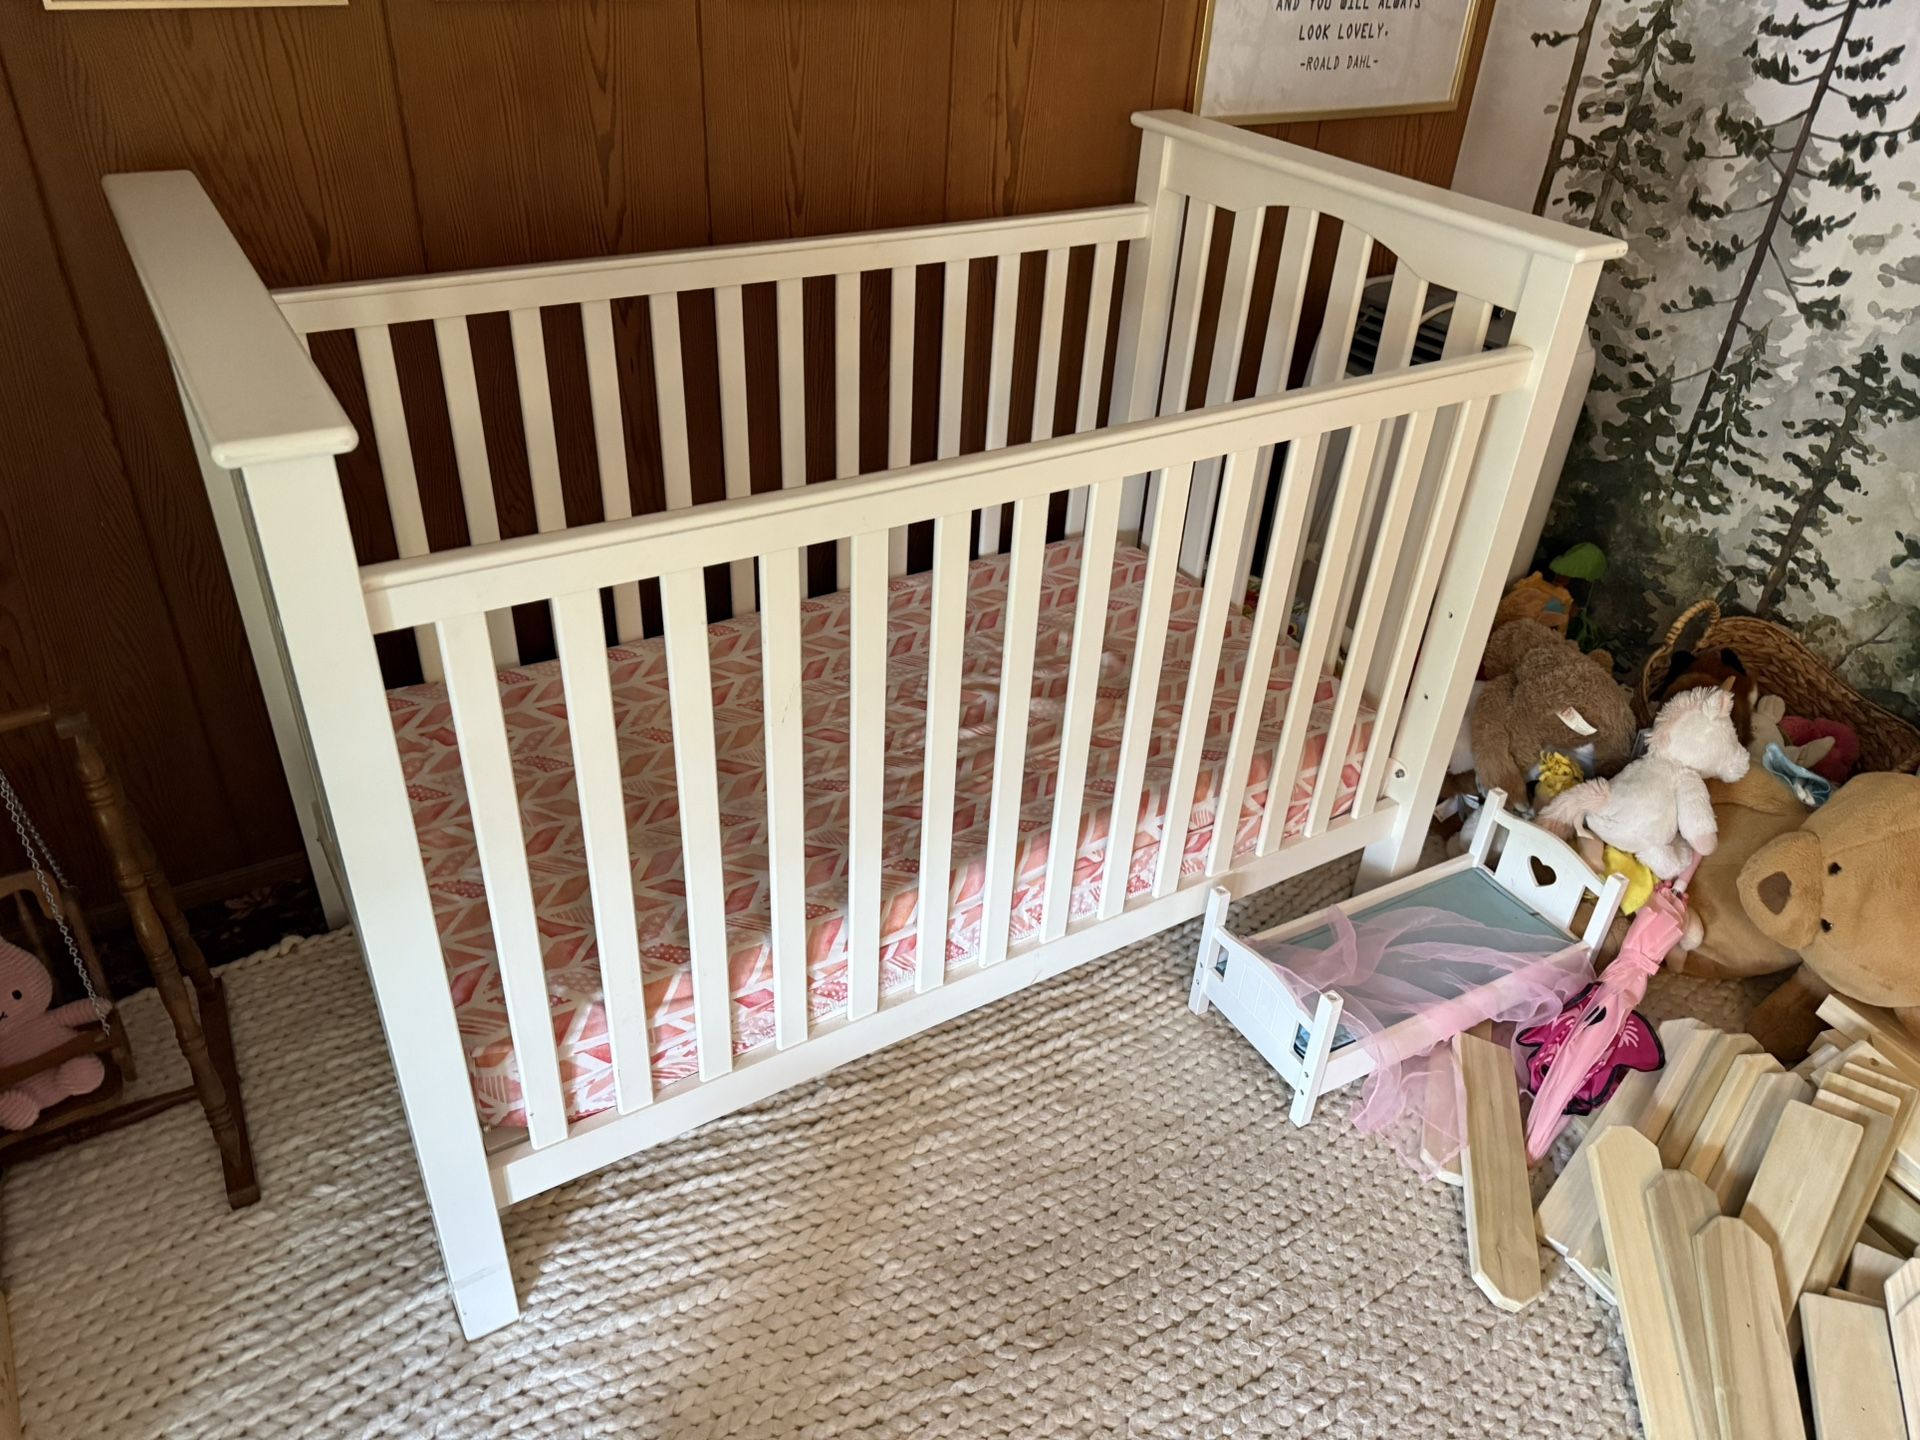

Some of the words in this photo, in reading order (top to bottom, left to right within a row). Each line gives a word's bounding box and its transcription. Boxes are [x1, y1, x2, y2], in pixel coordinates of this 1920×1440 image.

[1276, 0, 1300, 11] AND
[1310, 0, 1331, 10] YOU
[1339, 0, 1369, 10] WILL
[1378, 0, 1421, 10] ALWAYS
[1299, 24, 1331, 41] LOOK
[1338, 22, 1389, 40] LOVELY.
[1300, 56, 1340, 71] -ROALD
[1347, 54, 1379, 69] DAHL-
